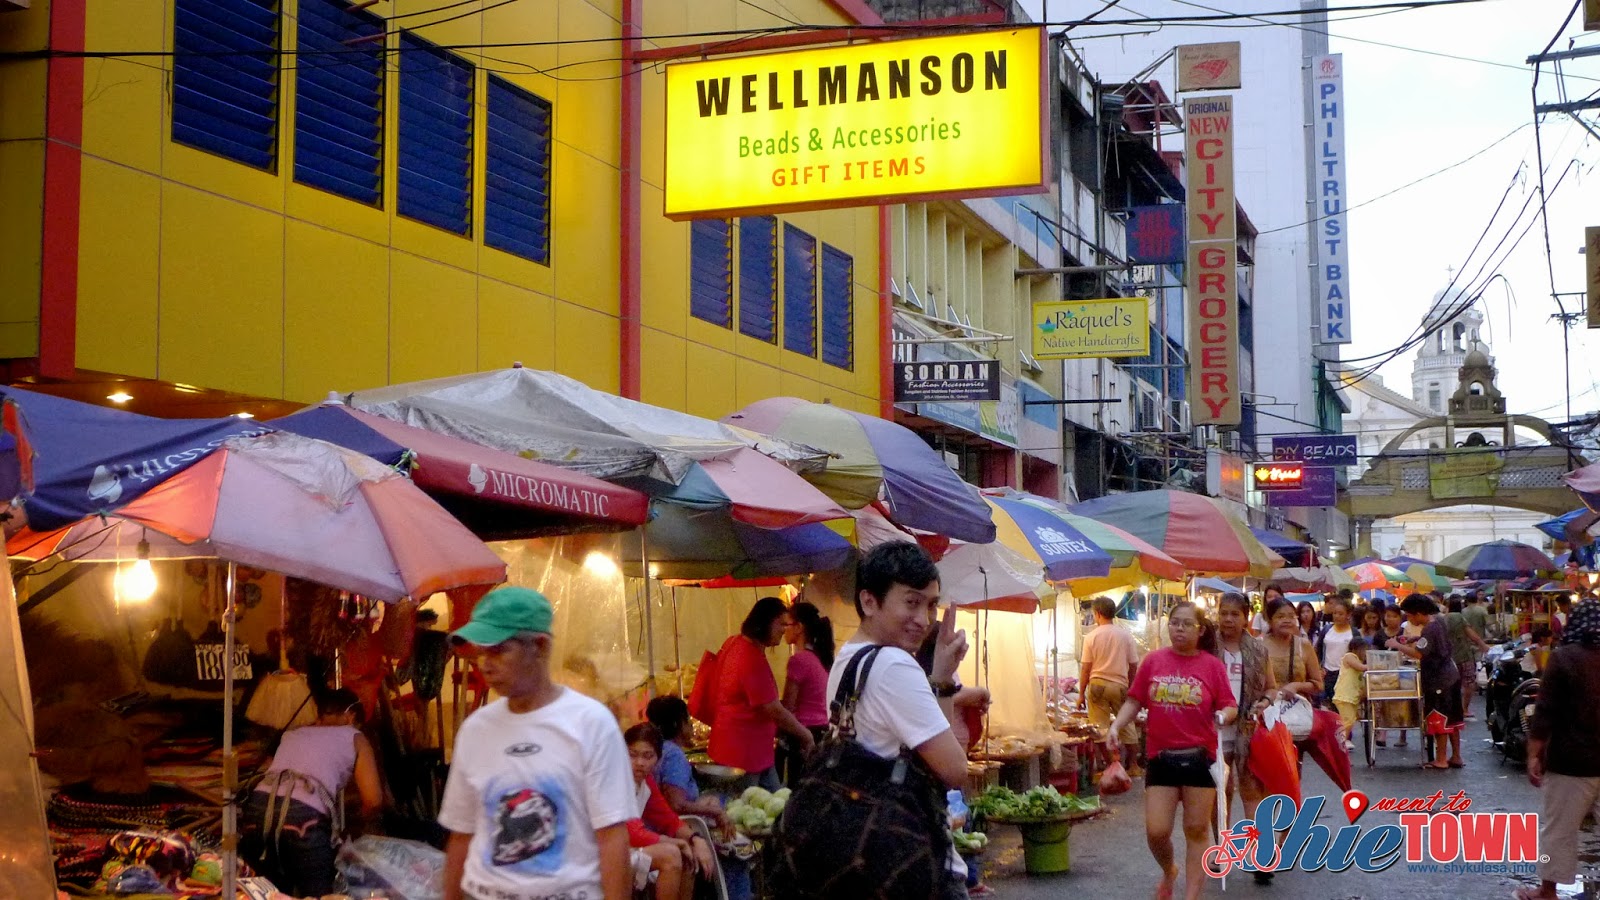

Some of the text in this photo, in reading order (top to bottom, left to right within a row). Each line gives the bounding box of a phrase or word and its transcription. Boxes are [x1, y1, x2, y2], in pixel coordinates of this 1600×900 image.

[696, 49, 1007, 118] WELLMANSON
[1188, 102, 1229, 115] ORIGINAL
[739, 117, 962, 158] Beads & Accessories
[1189, 116, 1230, 136] NEW
[771, 156, 927, 187] GIFT ITEMS
[1320, 83, 1341, 256] PHILTRUST
[1195, 138, 1225, 235] CITY
[1326, 264, 1344, 339] BANK
[1055, 305, 1132, 335] Raquel's
[1197, 248, 1230, 419] GROCERY
[1043, 332, 1140, 349] Native Handicrafts
[904, 363, 989, 381] SORDAN
[908, 380, 985, 389] Fashion Accessories
[1275, 443, 1355, 460] DIY BEADS
[491, 469, 610, 518] MICROMATIC
[1039, 539, 1093, 556] SUNTEX
